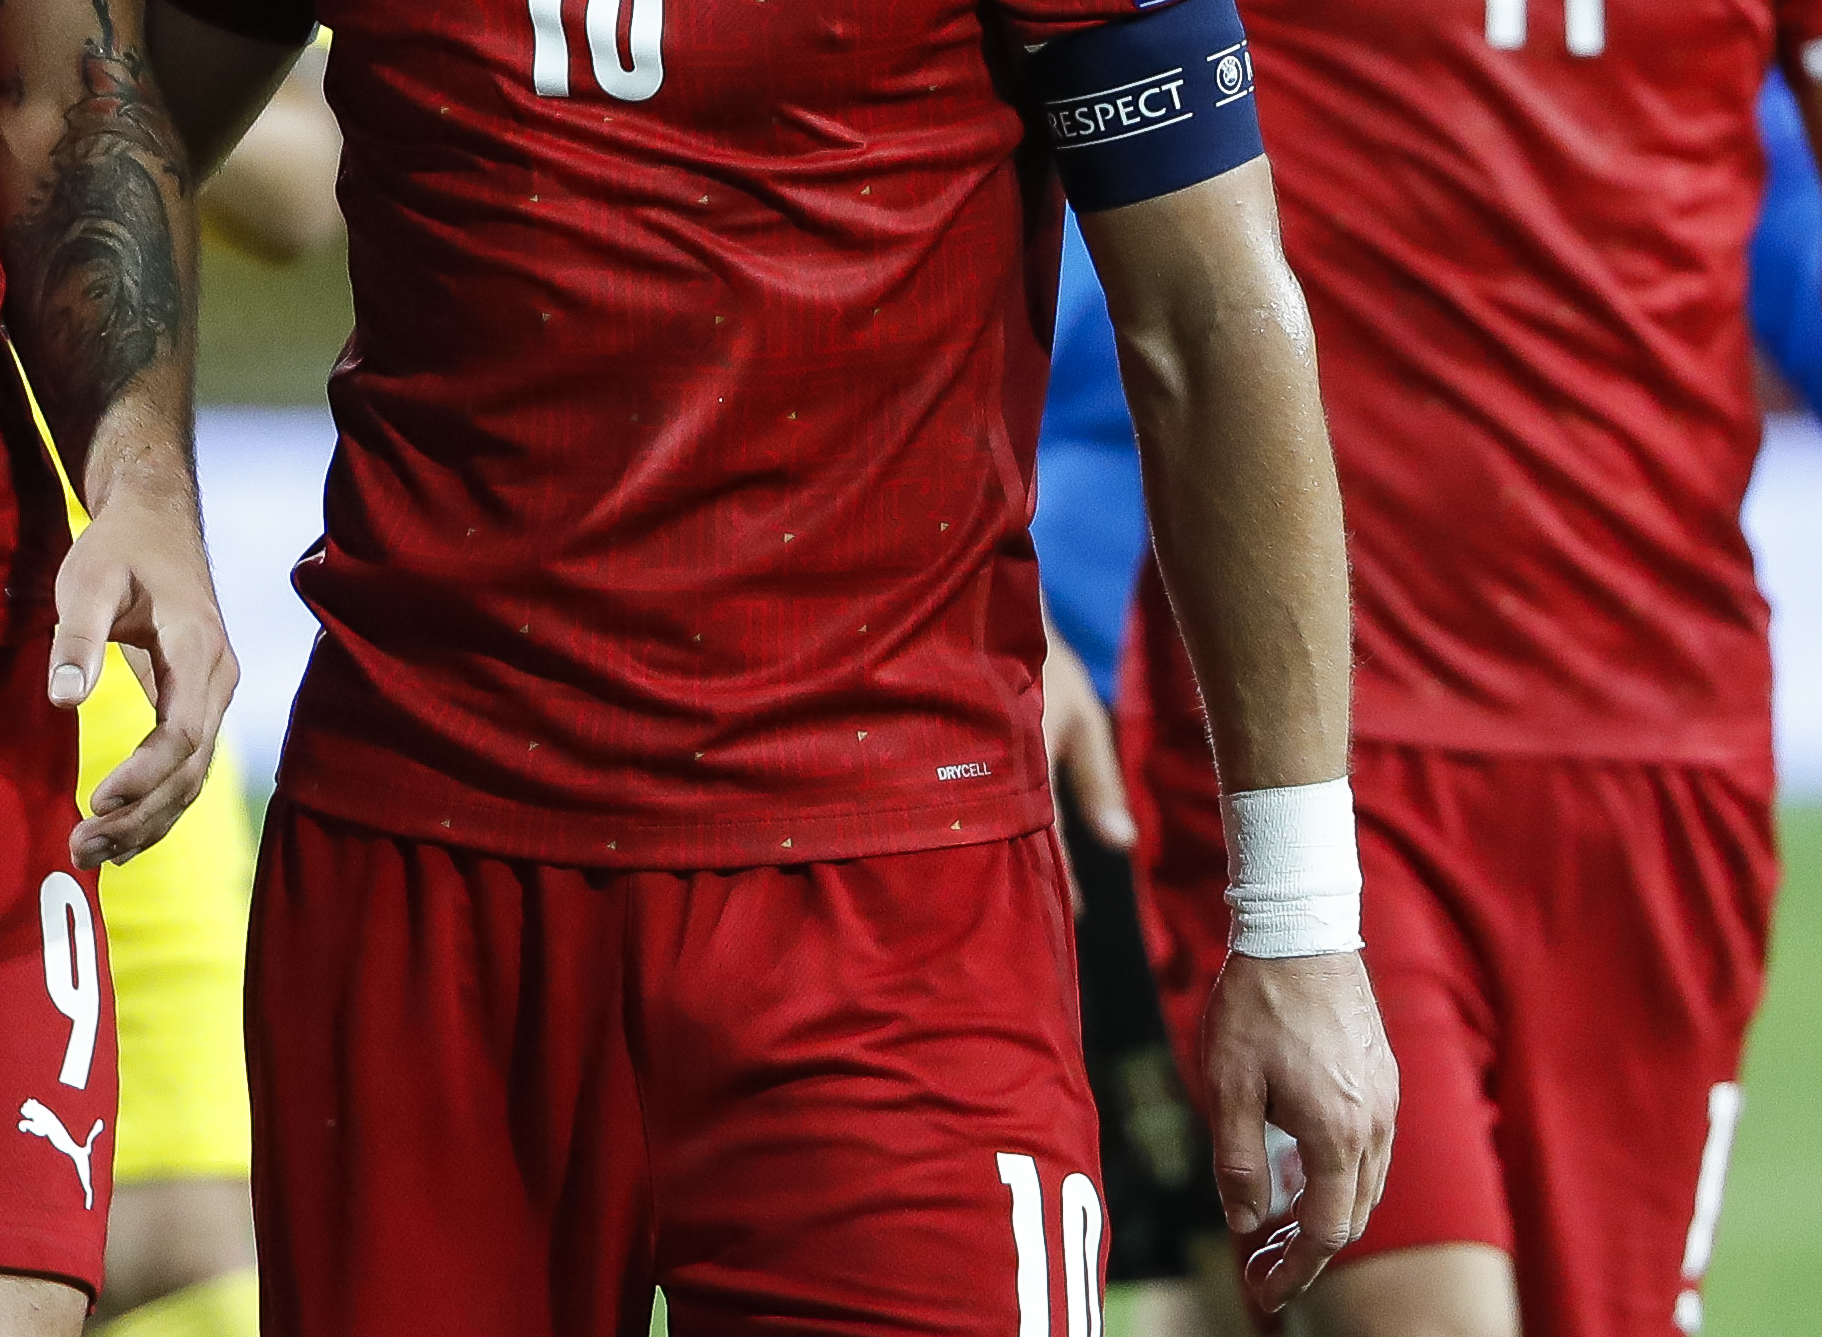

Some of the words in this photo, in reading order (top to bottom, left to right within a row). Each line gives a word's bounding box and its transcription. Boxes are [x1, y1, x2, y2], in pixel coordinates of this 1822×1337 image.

[1047, 79, 1184, 138] RESPECT
[937, 761, 992, 781] DRYCELL
[39, 870, 100, 1090] 9
[995, 1151, 1104, 1337] 10
